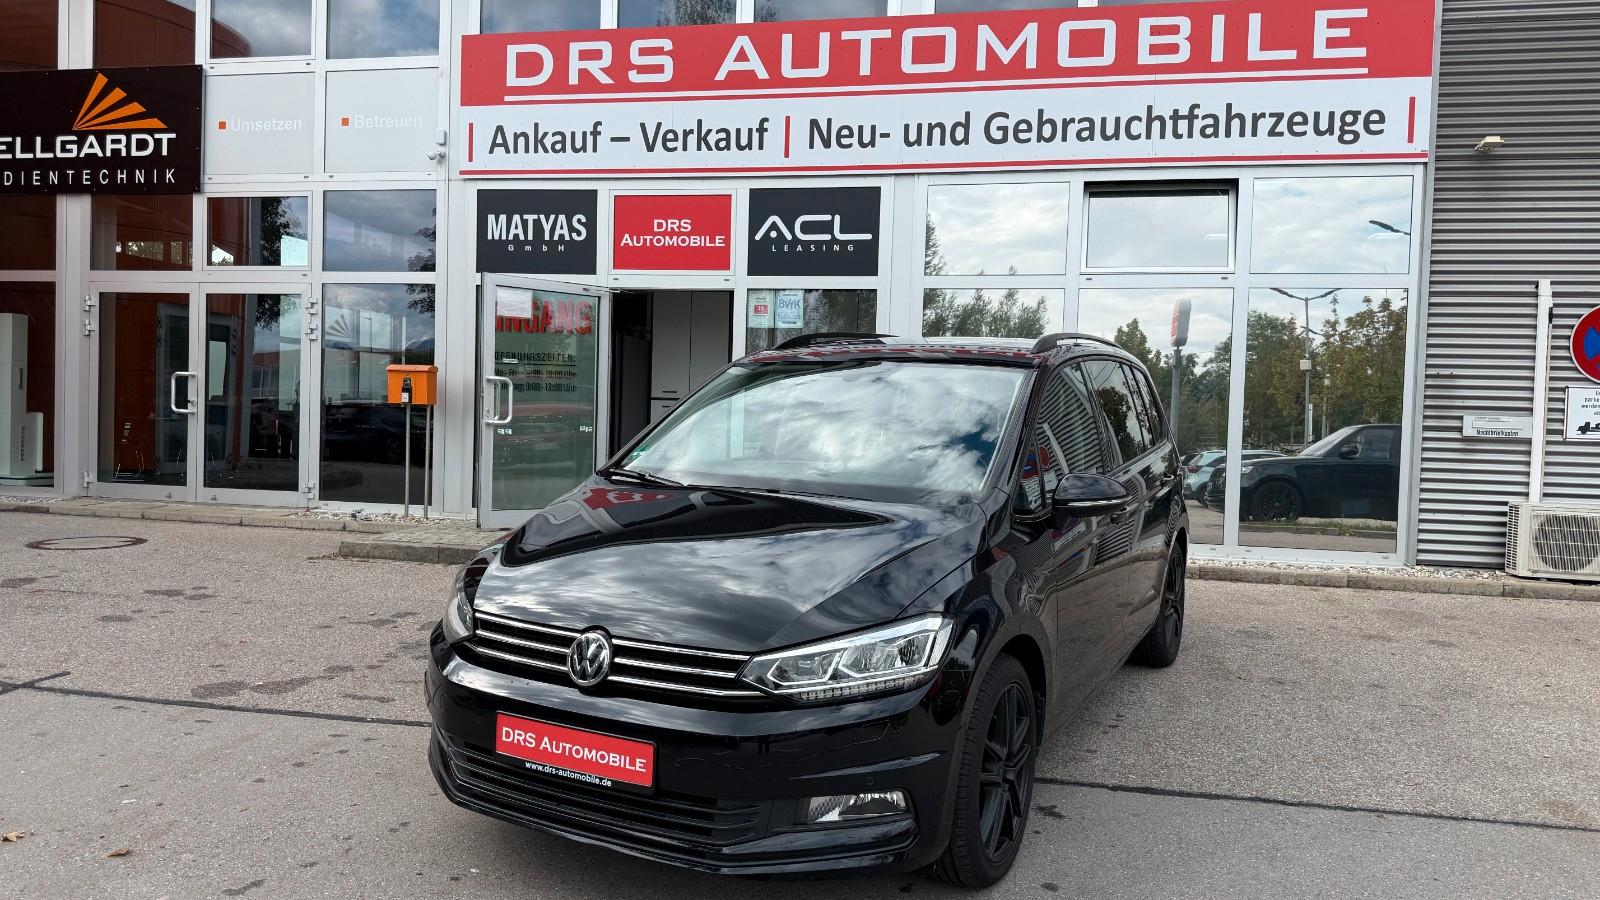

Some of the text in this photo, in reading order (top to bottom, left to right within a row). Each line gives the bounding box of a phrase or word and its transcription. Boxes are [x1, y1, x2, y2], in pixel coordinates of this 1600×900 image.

[505, 8, 1369, 87] DRS AUTOMOBILE
[230, 117, 302, 132] Umsetzen
[354, 114, 423, 129] Betreuen
[488, 120, 602, 155] Ankauf
[639, 117, 769, 153] Verkauf
[808, 117, 891, 150] Neu-
[903, 110, 971, 147] und
[983, 103, 1386, 145] Gebrauchtfahrzeuge
[3, 168, 176, 186] DIENTECHNIK
[487, 214, 588, 241] MATYAS
[653, 218, 692, 232] DRS
[754, 214, 873, 241] ACL
[507, 244, 566, 252] GmbH
[620, 233, 726, 248] AUTOMOBILE
[771, 243, 855, 252] LEASING
[502, 726, 647, 773] DRS AUTOMOBILE
[525, 760, 612, 787] www.drs-automobile.de
